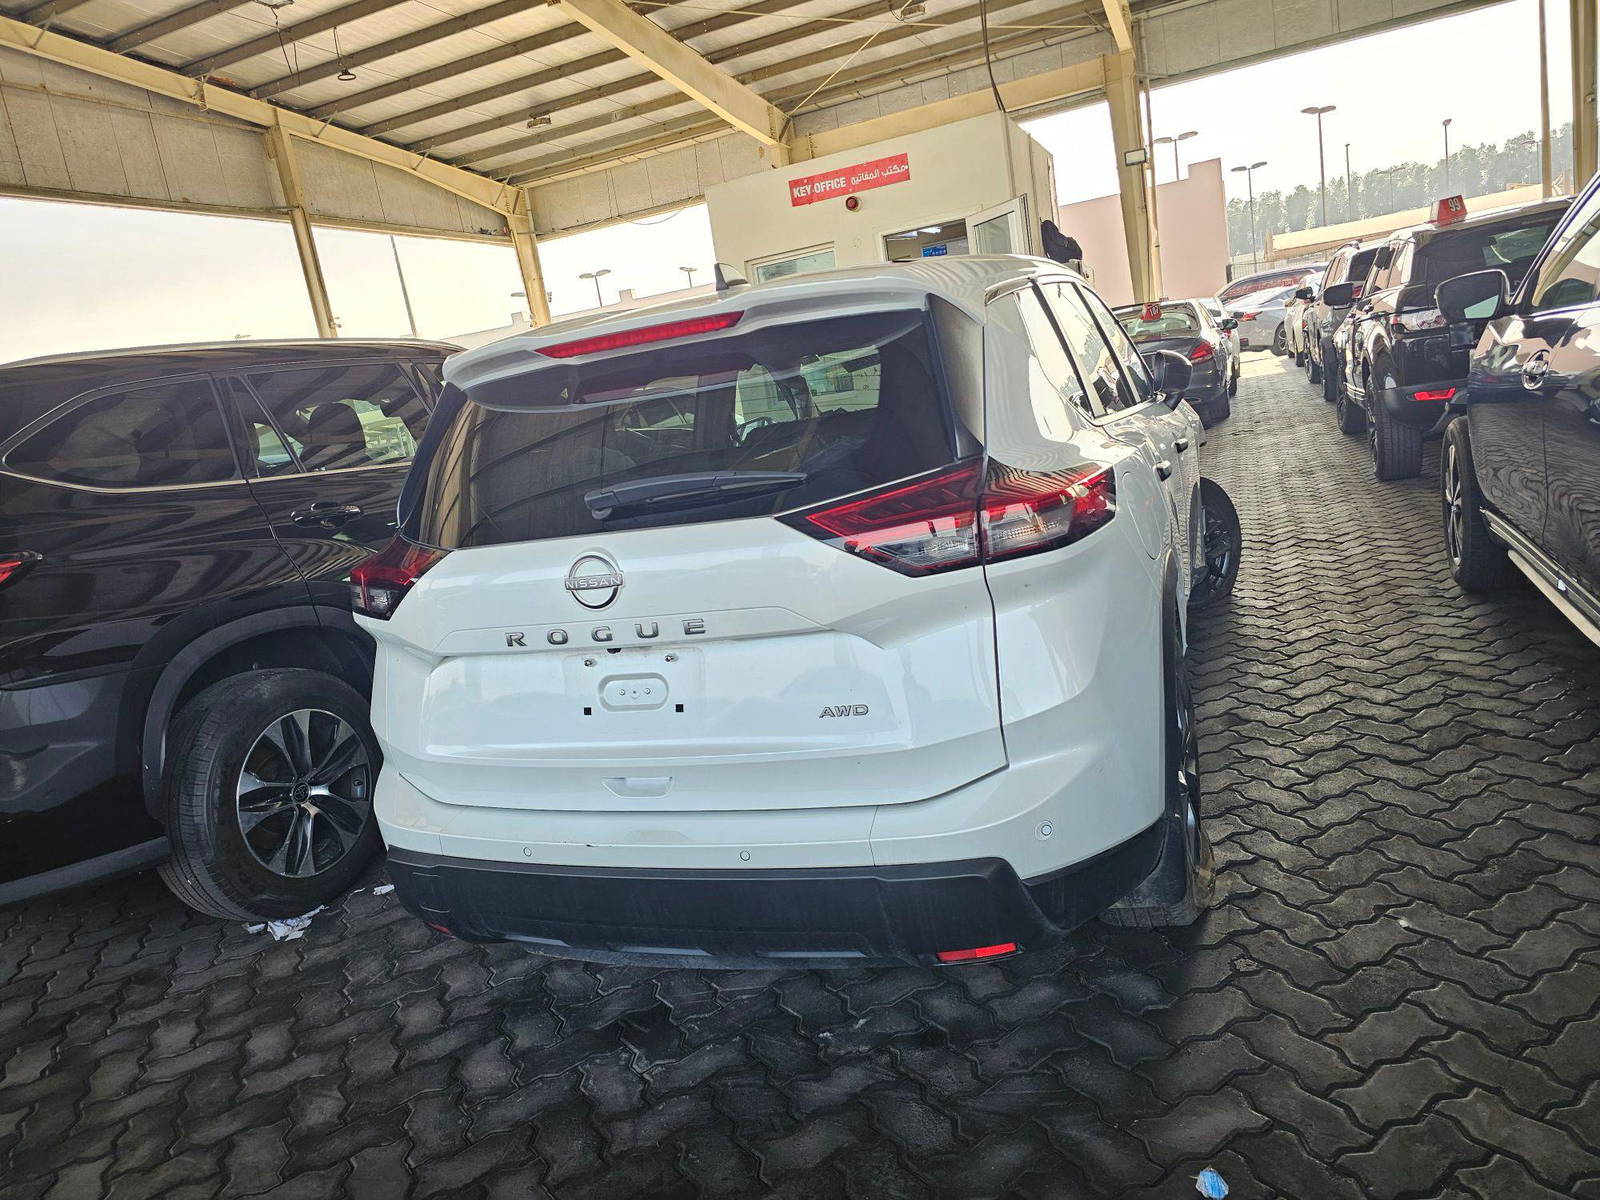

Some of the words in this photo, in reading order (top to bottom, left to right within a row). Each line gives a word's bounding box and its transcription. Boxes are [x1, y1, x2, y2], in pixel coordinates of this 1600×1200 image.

[881, 164, 906, 178] مكتب
[793, 184, 812, 198] KEY
[814, 177, 847, 194] OFFICE
[565, 576, 621, 589] NISSAN
[505, 618, 706, 647] ROGUE
[819, 704, 869, 719] AWD
